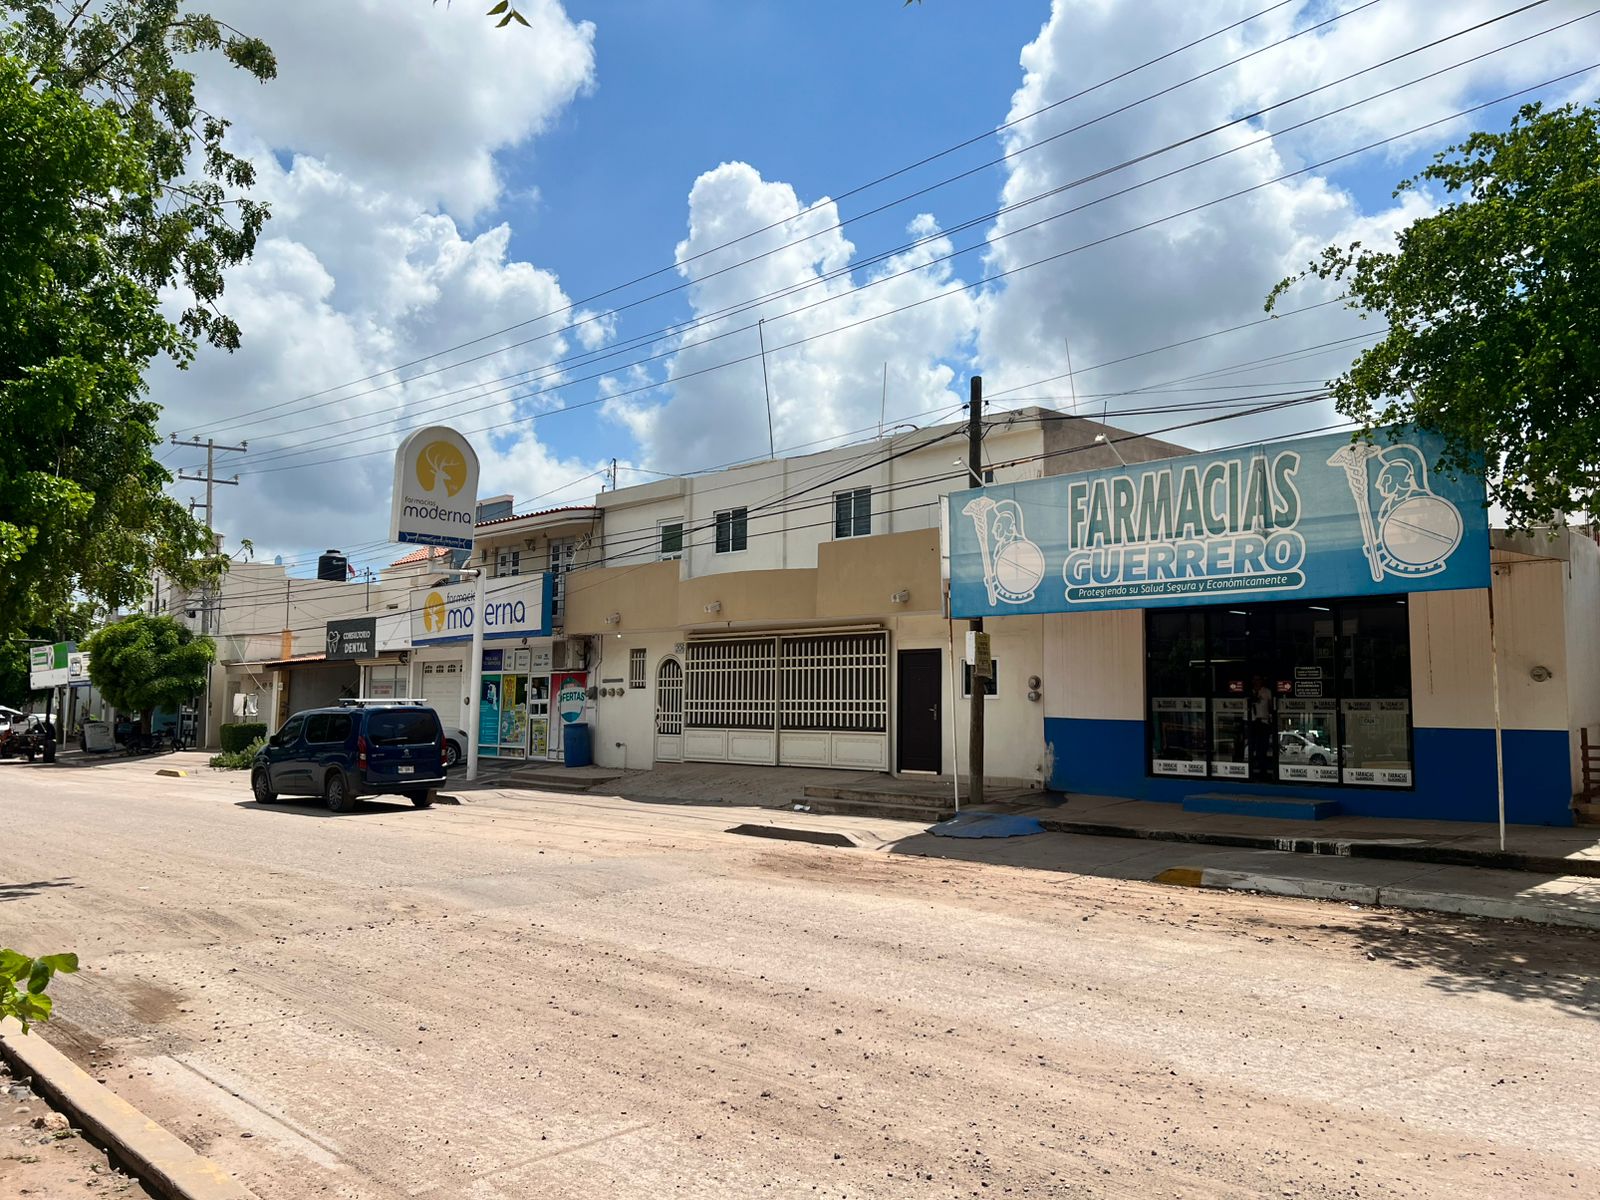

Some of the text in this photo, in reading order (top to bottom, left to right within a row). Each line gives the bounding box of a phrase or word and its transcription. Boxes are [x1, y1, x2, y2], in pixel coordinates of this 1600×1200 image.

[1068, 450, 1301, 551] FARMACIAS
[403, 505, 472, 525] moderna
[1064, 531, 1305, 587] GUERRERO
[1078, 574, 1287, 598] Protegiendo su Salud Segura y Económicamente
[447, 600, 525, 630] moerna
[344, 642, 368, 653] DENTAL
